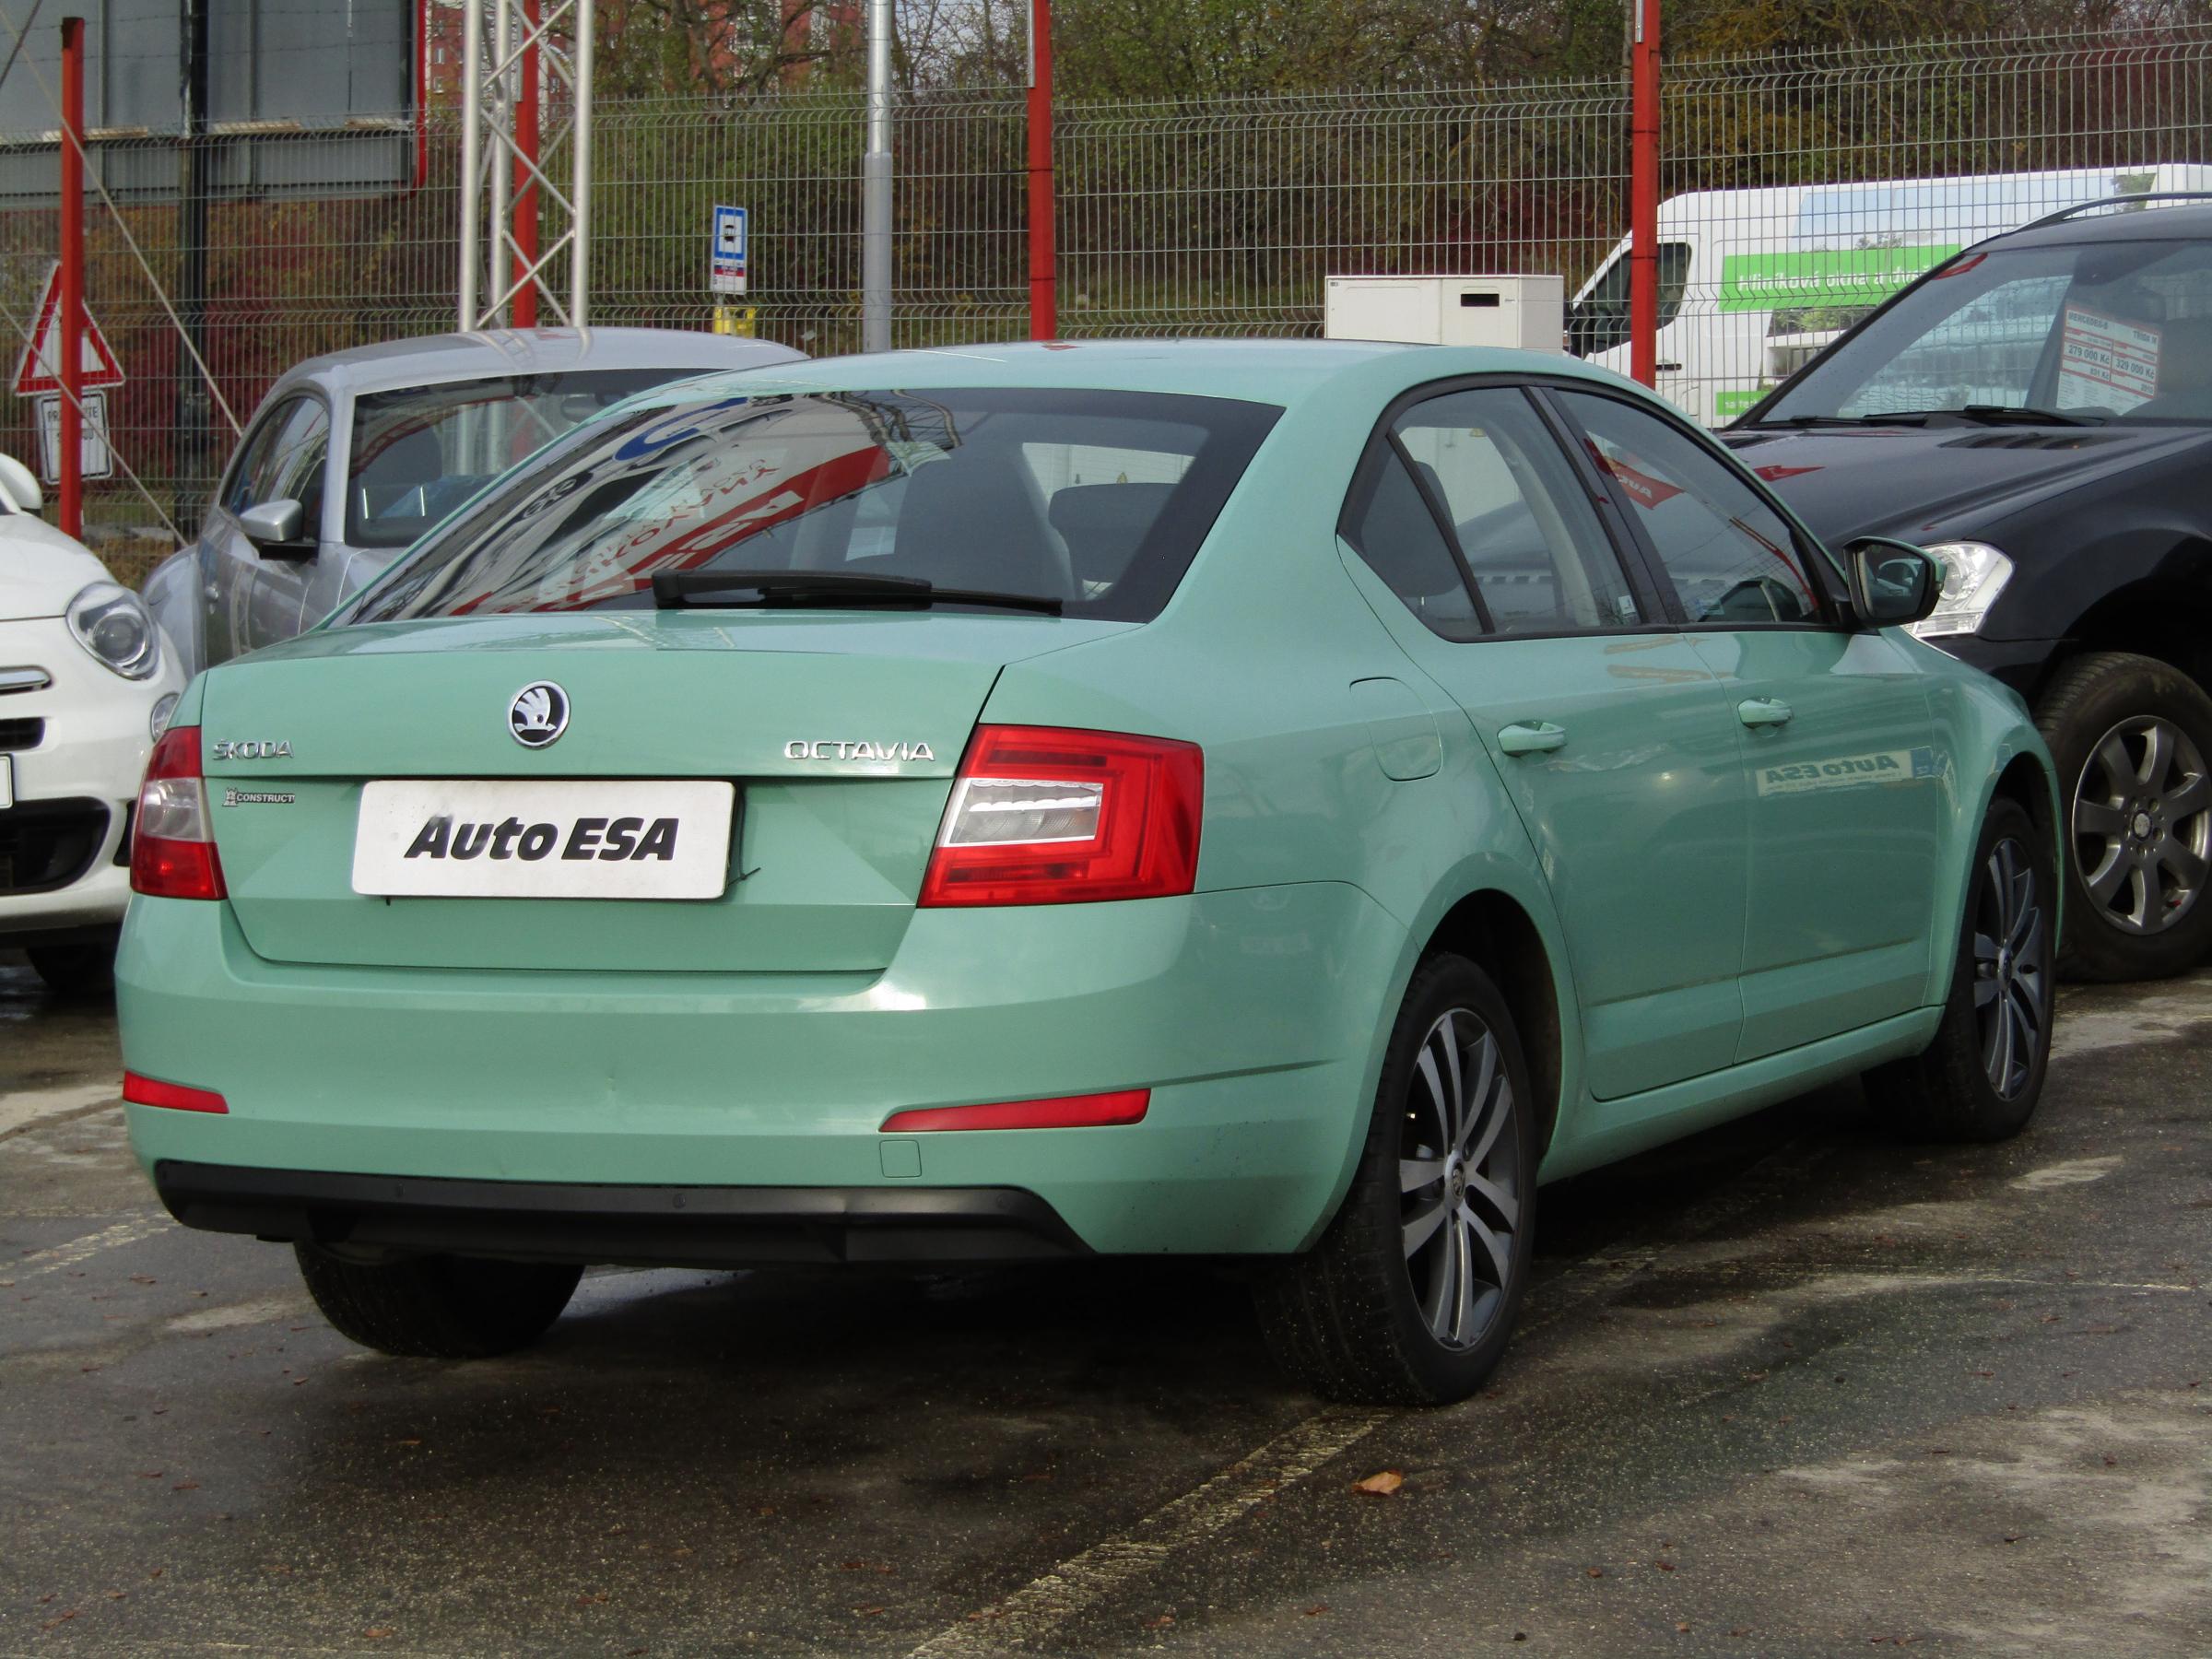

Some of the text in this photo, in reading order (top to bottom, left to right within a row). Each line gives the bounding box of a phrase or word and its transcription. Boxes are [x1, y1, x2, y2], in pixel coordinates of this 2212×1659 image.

[1738, 271, 1820, 291] Hliníková
[1826, 270, 1867, 288] okna
[2068, 344, 2083, 357] 279
[2083, 348, 2098, 360] 000
[2130, 362, 2144, 375] 000
[212, 738, 295, 760] ŠKODA
[784, 741, 935, 761] OCTAVIA
[236, 793, 295, 804] CONSTRUCT
[404, 816, 679, 861] Auto ESA
